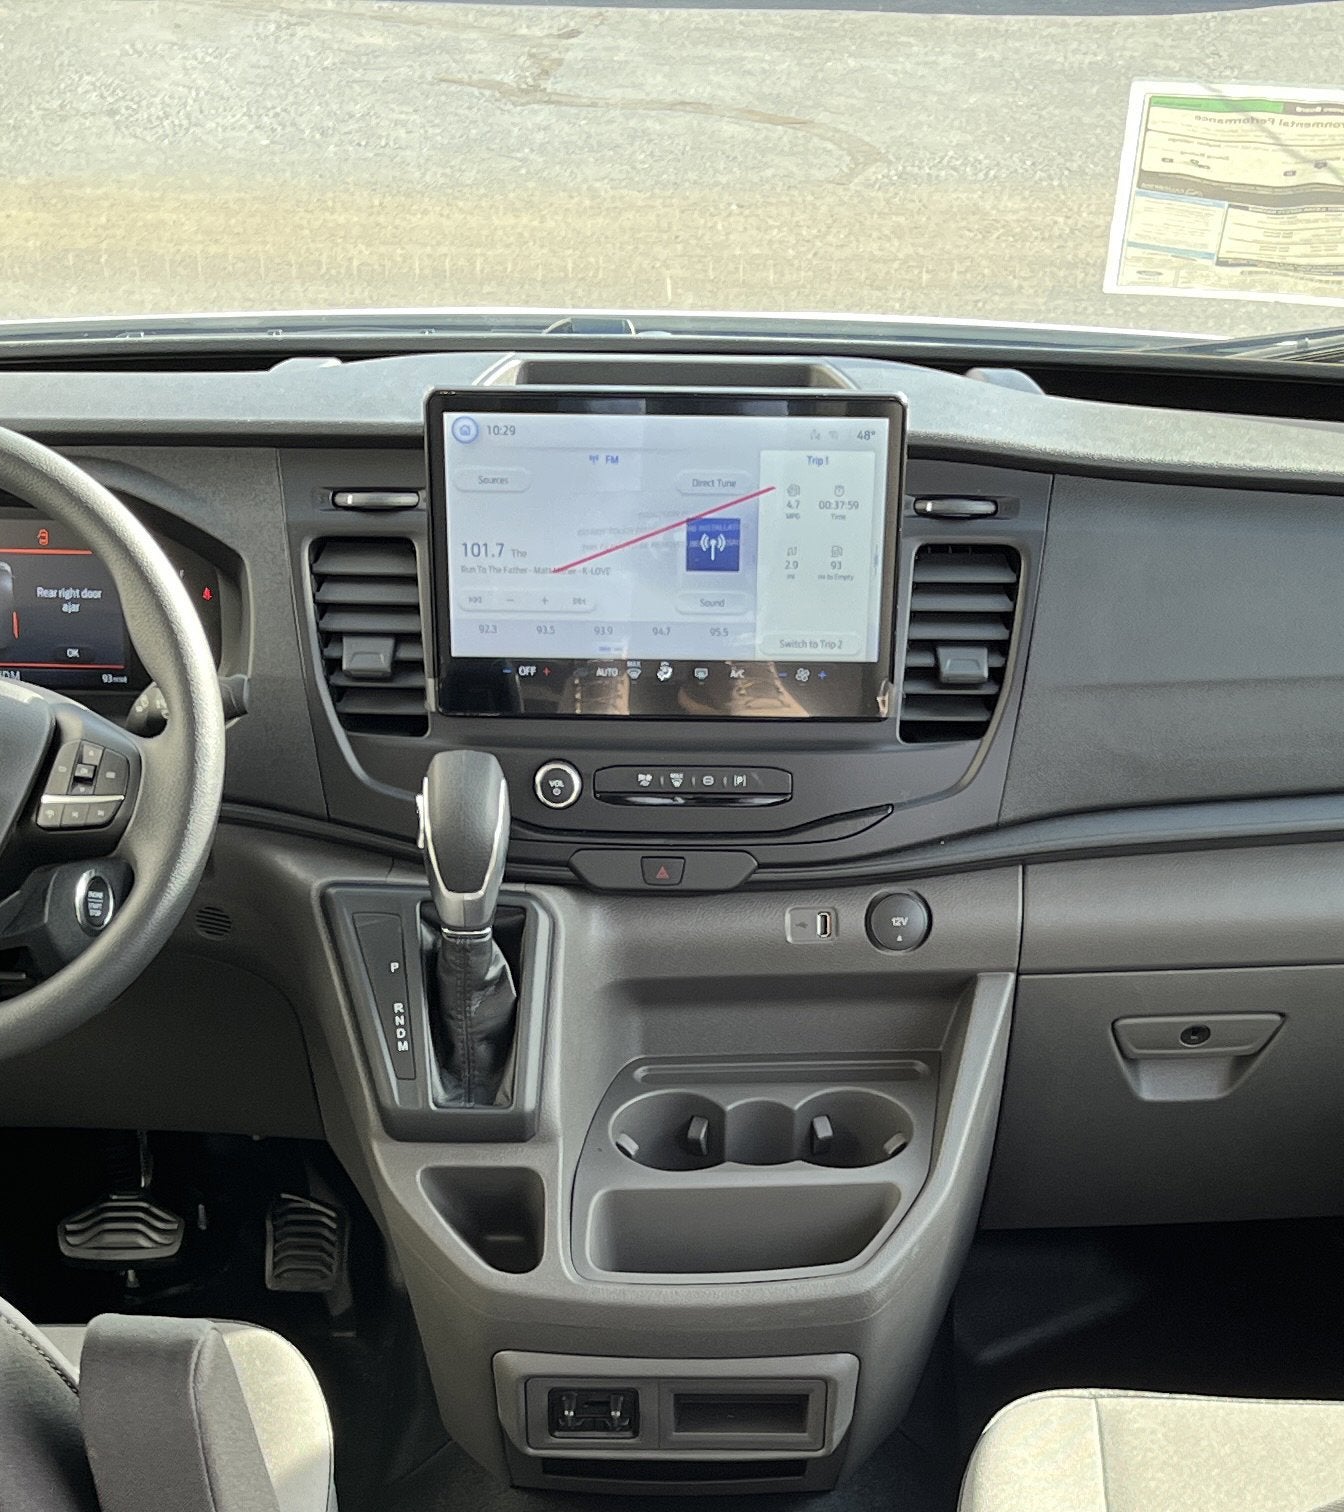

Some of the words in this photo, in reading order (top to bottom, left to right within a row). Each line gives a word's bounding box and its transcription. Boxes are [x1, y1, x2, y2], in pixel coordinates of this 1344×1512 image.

[486, 424, 516, 436] 10:29
[857, 430, 876, 441] 48°
[605, 455, 619, 465] FM
[806, 456, 824, 467] Trip
[478, 475, 509, 485] Sources
[692, 479, 715, 488] Direct
[717, 479, 737, 488] Tune
[786, 500, 800, 509] 4.7
[819, 500, 859, 510] 00:37:59
[462, 543, 505, 558] 101.7
[511, 549, 527, 559] The
[36, 586, 57, 599] Rear
[58, 586, 80, 600] right
[81, 587, 102, 599] door
[62, 602, 80, 613] ajar
[700, 599, 725, 608] Sound
[478, 624, 498, 634] 92.3
[780, 640, 808, 649] Switch
[810, 640, 819, 649] to
[820, 640, 837, 650] Trip
[66, 648, 80, 658] OK
[518, 666, 536, 676] OFF
[596, 667, 618, 677] AUTO
[892, 916, 909, 927] 12V
[390, 962, 399, 973] P
[394, 1002, 405, 1014] R
[395, 1015, 405, 1026] N
[396, 1028, 406, 1039] D
[398, 1040, 409, 1052] M
